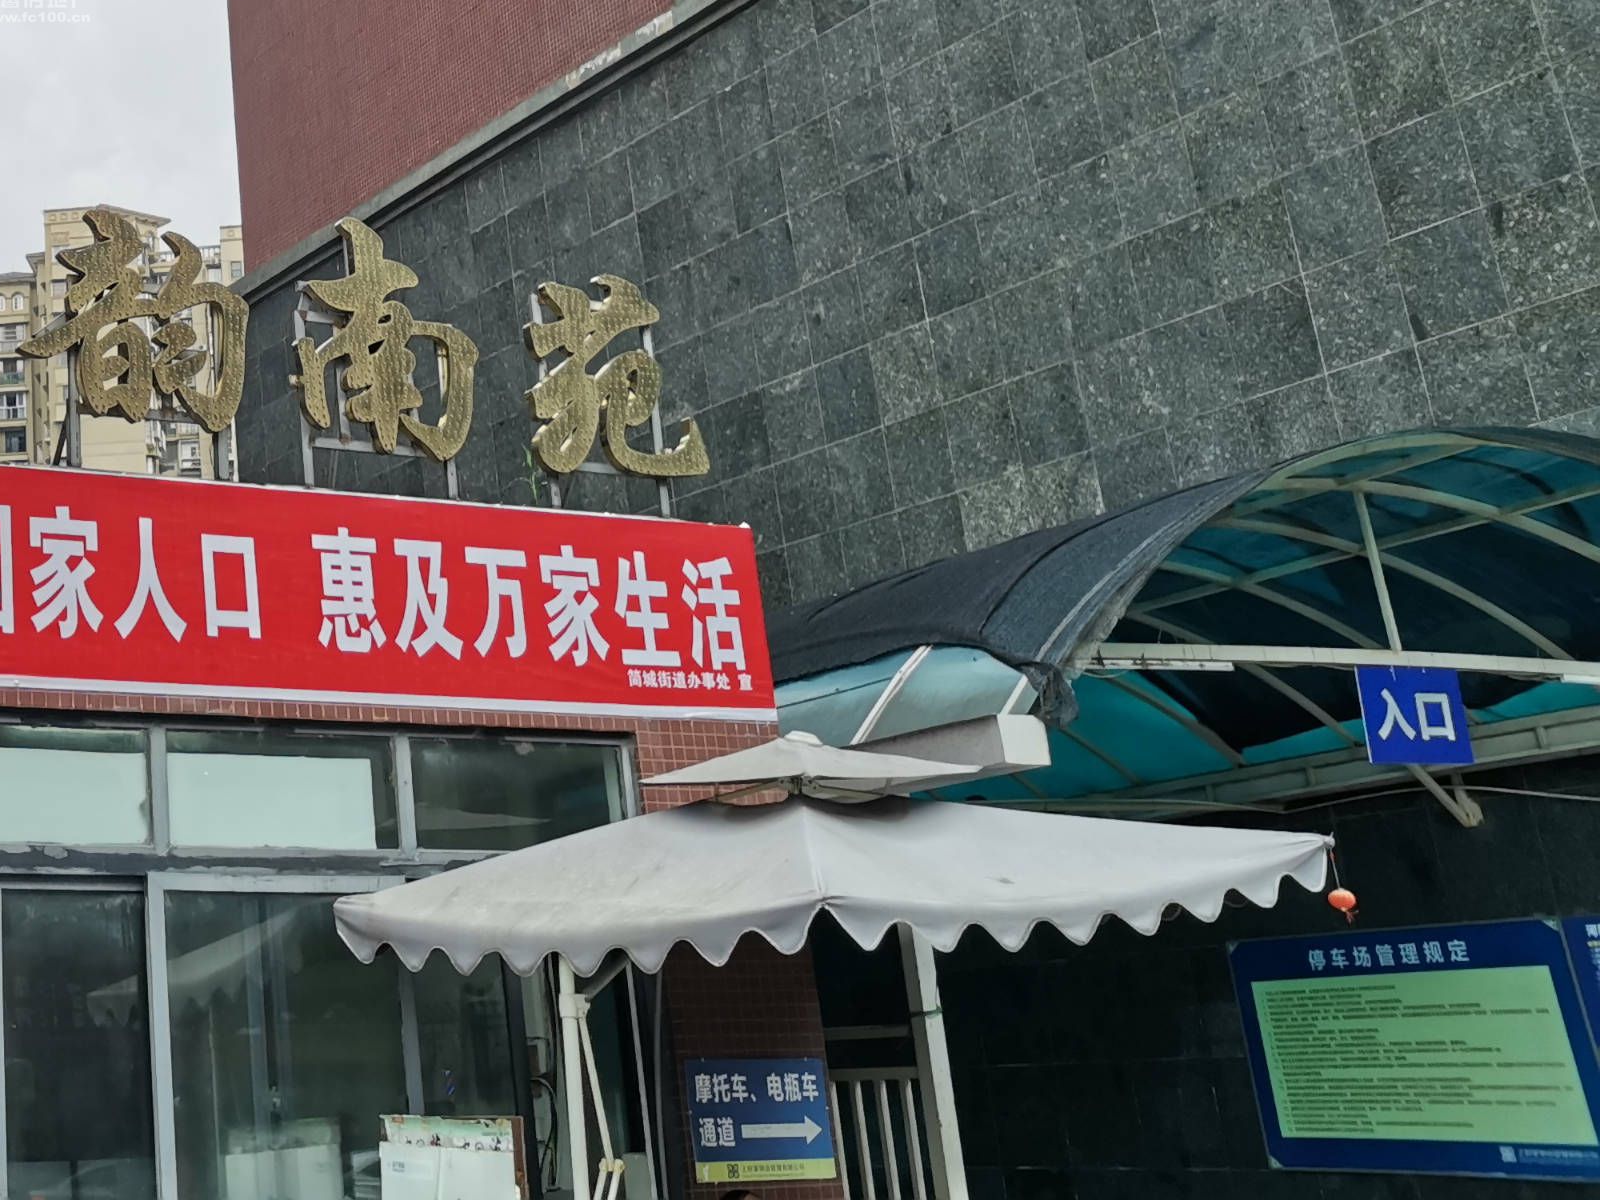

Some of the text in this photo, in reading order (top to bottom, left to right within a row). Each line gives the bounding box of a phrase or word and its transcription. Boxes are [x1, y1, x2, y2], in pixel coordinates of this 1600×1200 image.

[310, 526, 747, 671] 惠及万家生活
[627, 668, 753, 691] 简城街道办事处 宣
[1378, 688, 1456, 741] 入口
[1307, 938, 1471, 972] 停车场管理规定
[694, 1072, 820, 1103] 摩托车、电瓶车
[698, 1116, 737, 1148] 通道
